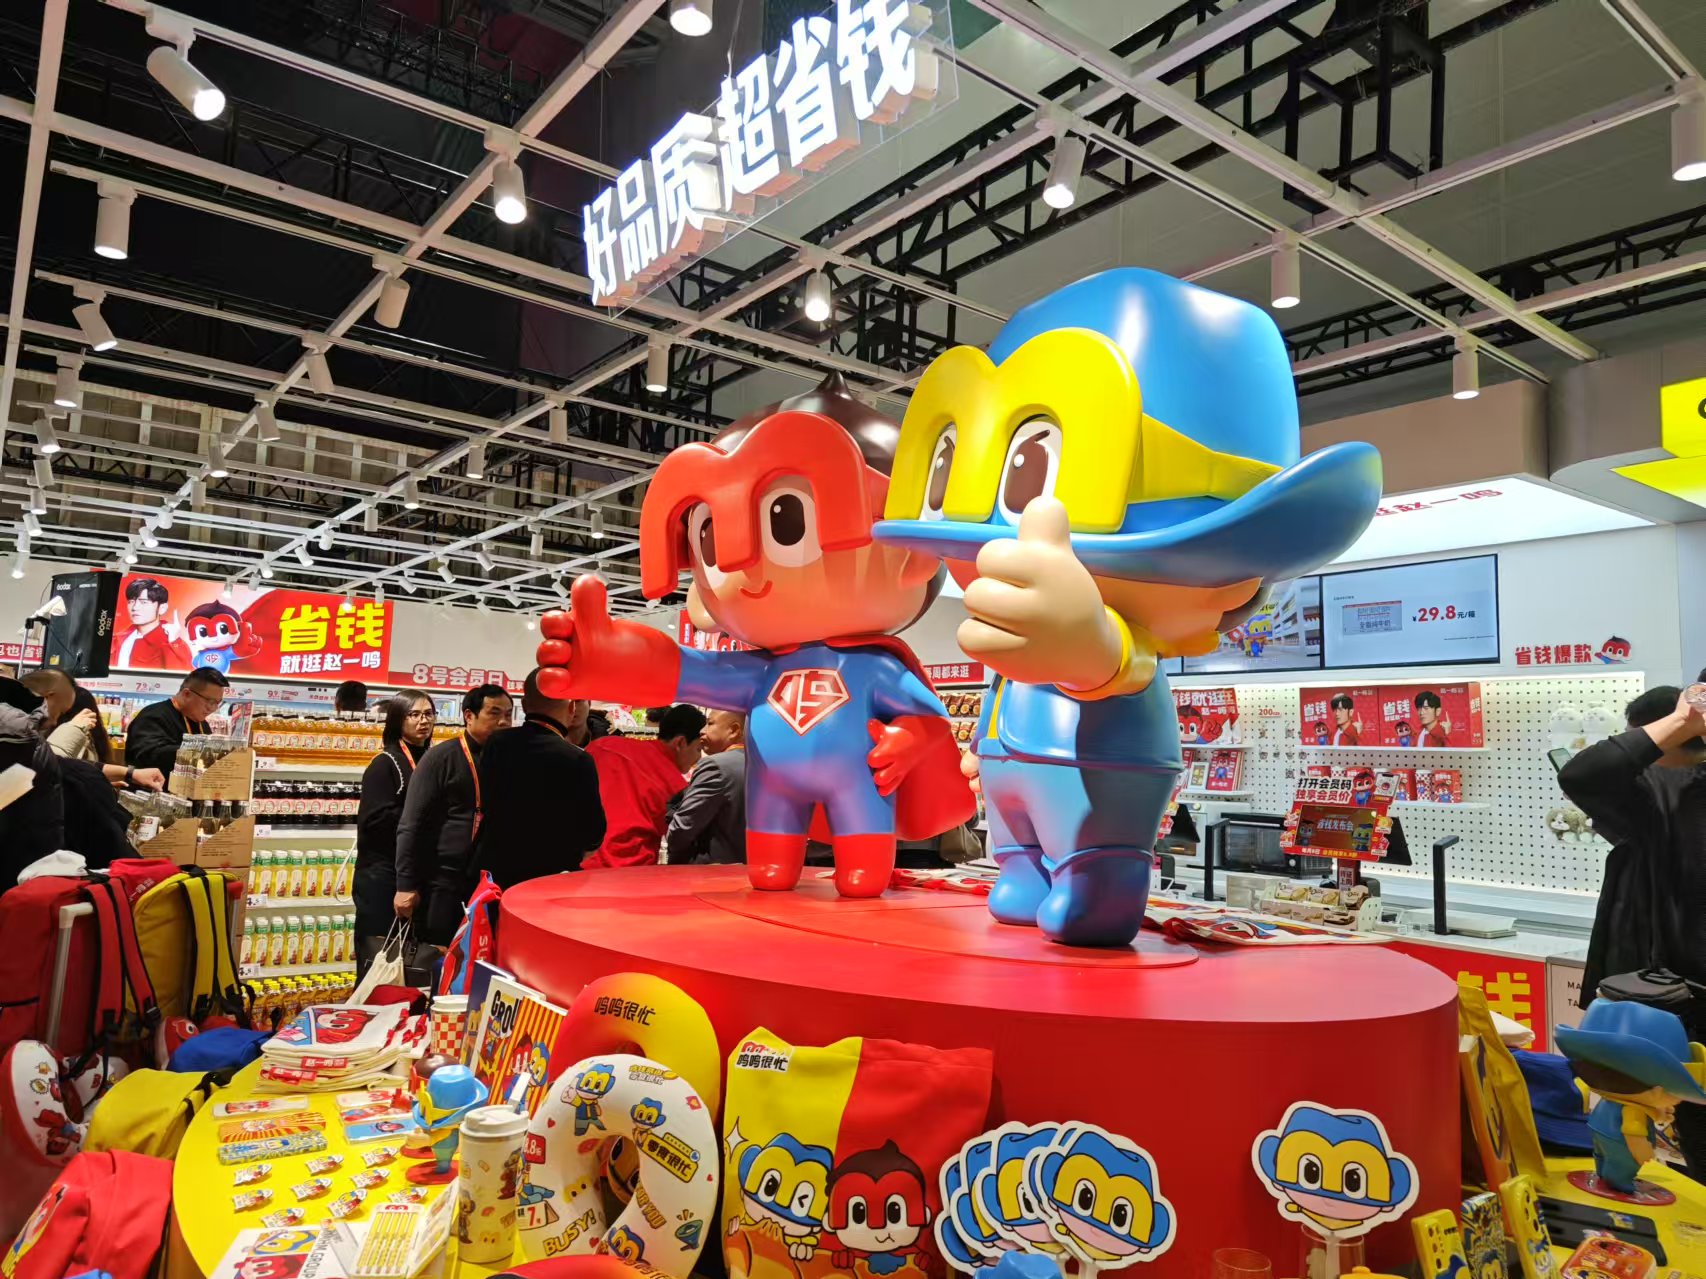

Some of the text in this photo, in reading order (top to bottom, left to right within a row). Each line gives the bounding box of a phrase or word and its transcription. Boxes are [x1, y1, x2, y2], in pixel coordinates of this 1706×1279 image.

[279, 602, 385, 652] 省钱
[280, 651, 381, 674] 就逛赵一鸣
[1515, 643, 1592, 666] 省钱爆款
[1295, 789, 1350, 802] 独享会员价
[1298, 778, 1352, 790] 打开会员码
[543, 1208, 597, 1257] BUSY!
